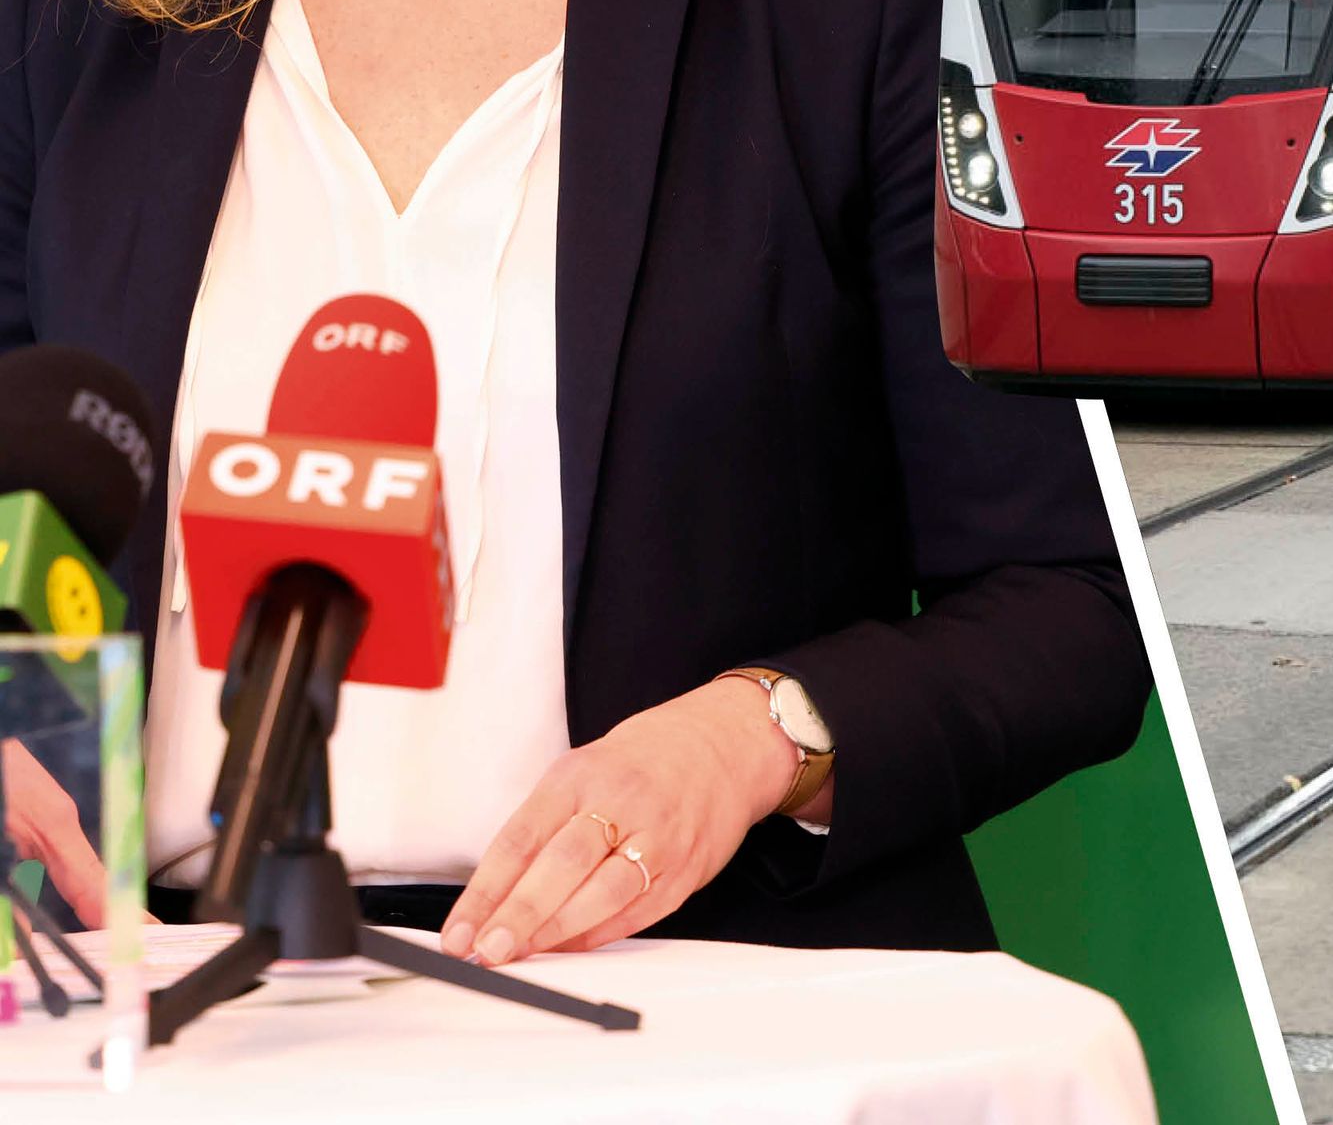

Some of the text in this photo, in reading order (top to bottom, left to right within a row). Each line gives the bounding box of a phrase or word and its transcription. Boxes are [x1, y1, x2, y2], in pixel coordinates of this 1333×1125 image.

[1114, 183, 1184, 225] 315
[312, 322, 410, 356] ORF
[208, 442, 429, 512] ORF
